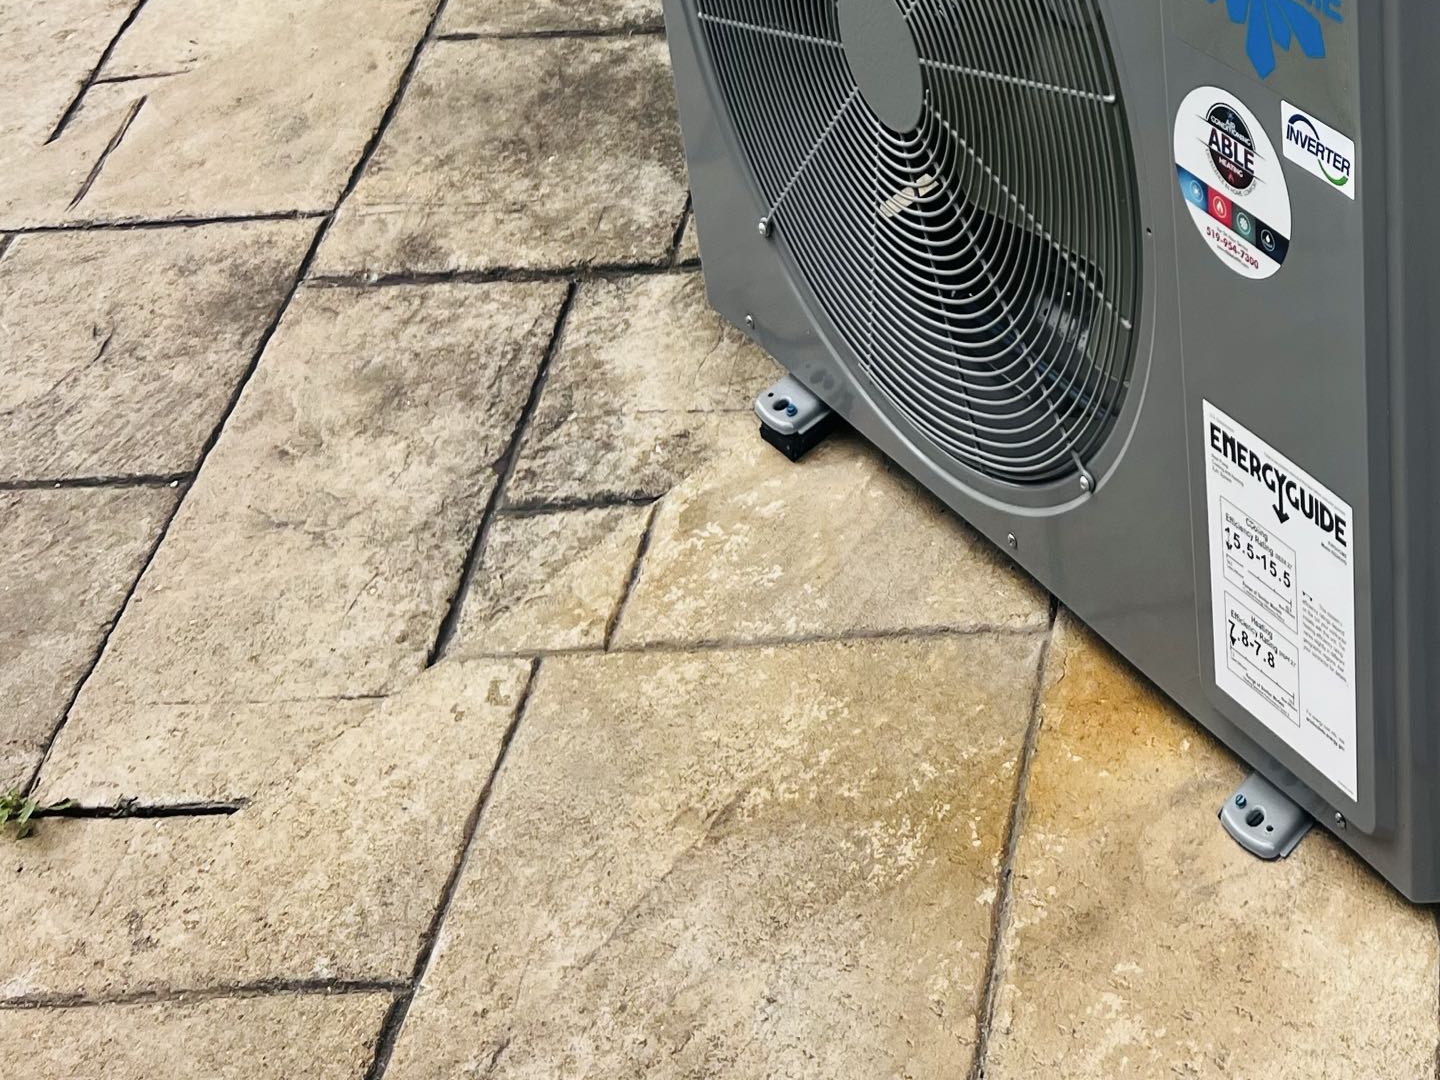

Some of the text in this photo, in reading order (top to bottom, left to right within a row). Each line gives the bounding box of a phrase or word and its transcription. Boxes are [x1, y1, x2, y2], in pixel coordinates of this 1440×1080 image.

[1210, 114, 1250, 147] CONDITIONING
[1225, 118, 1235, 130] AIR
[1208, 126, 1254, 173] ABLE
[1218, 155, 1243, 178] HEATING
[1286, 123, 1351, 177] INVERTER
[1206, 225, 1258, 269] 519-954-7300
[1209, 422, 1346, 545] ENERGYGUIDE
[1224, 524, 1290, 589] 15.5-15.5
[1225, 512, 1273, 558] Efficiency Rating
[1228, 619, 1275, 669] 7.8-7.8
[1230, 608, 1258, 638] Efficiency
[1259, 631, 1278, 655] Rating
[1250, 614, 1272, 641] Heating
